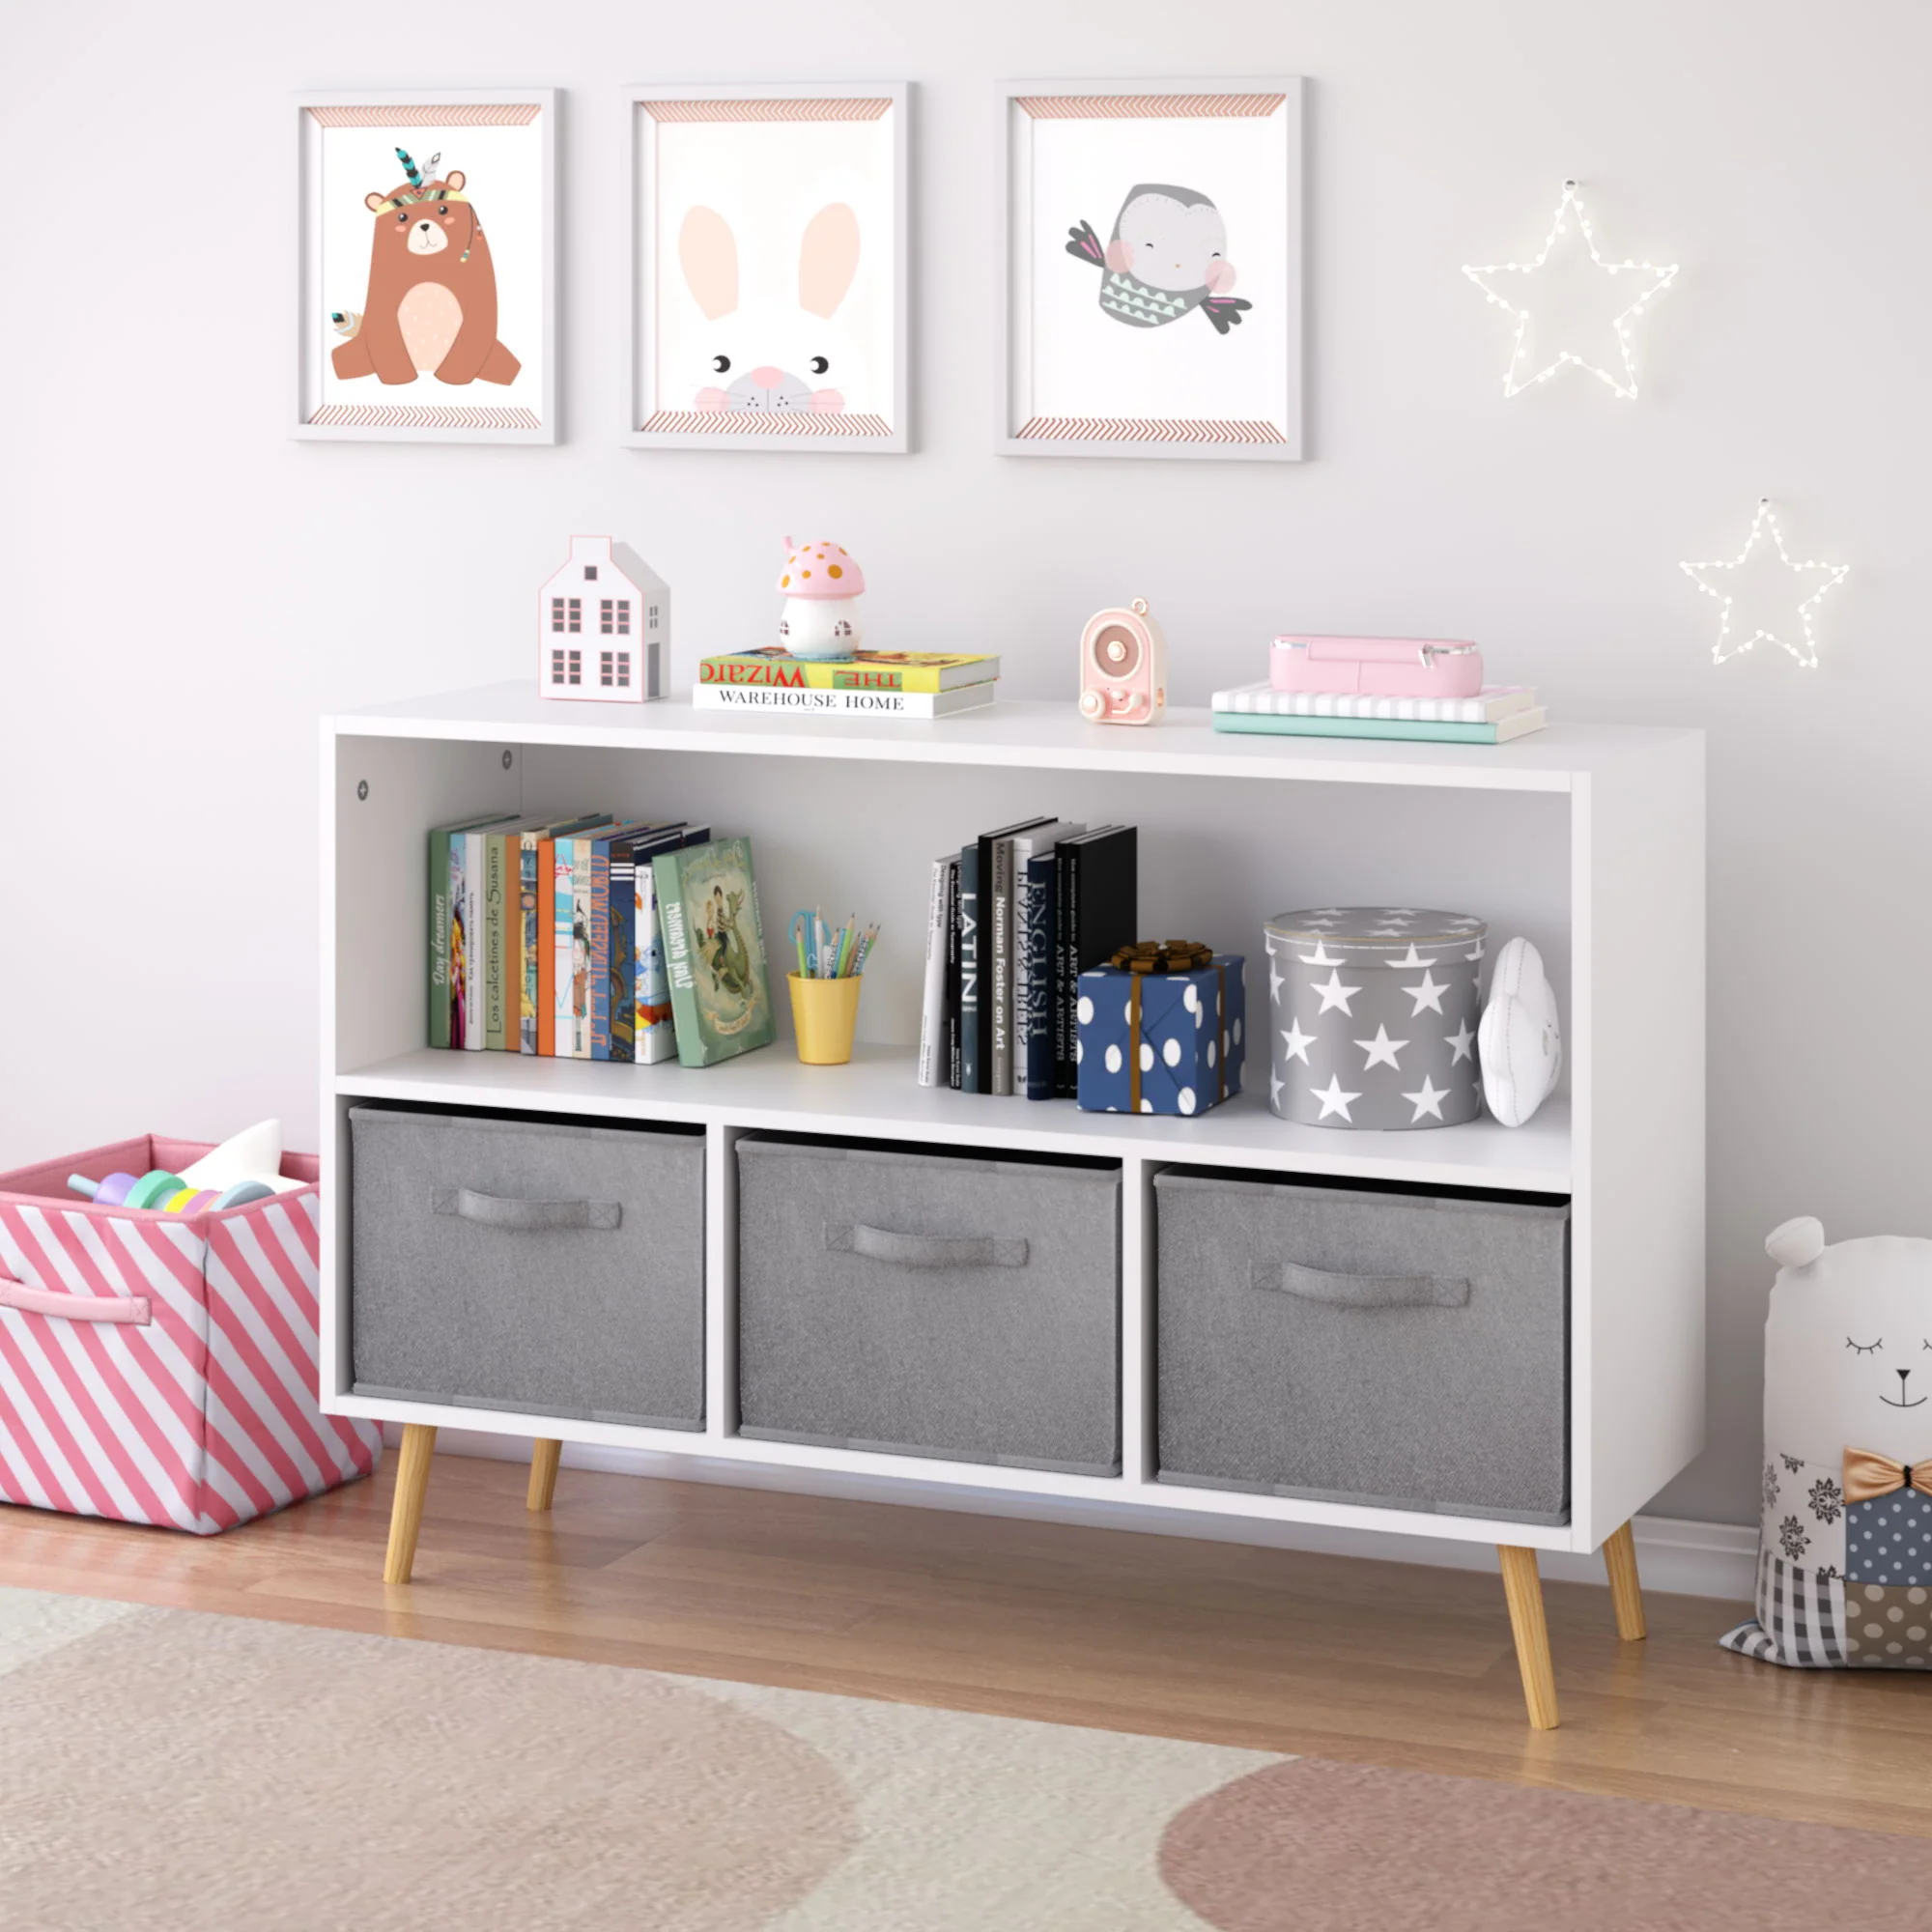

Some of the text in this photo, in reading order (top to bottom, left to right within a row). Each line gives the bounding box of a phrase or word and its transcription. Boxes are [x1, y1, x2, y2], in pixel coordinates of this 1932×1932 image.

[835, 670, 900, 688] THE
[719, 690, 904, 710] WAREHOUSE HOME
[995, 842, 1006, 893] Moving
[431, 894, 449, 986] Day dreamers
[486, 846, 501, 1034] Los calcetines de Susana
[996, 896, 1006, 953] Norman
[961, 893, 978, 1002] LATIN
[1032, 881, 1047, 1037] ENGLISH
[1056, 944, 1065, 977] ART
[1069, 944, 1078, 977] ART
[996, 957, 1006, 1002] Foster
[1056, 979, 1065, 993] &
[1069, 979, 1078, 993] &
[996, 1006, 1004, 1024] on
[1056, 995, 1065, 1061] ARTISTS
[996, 1027, 1006, 1050] Art
